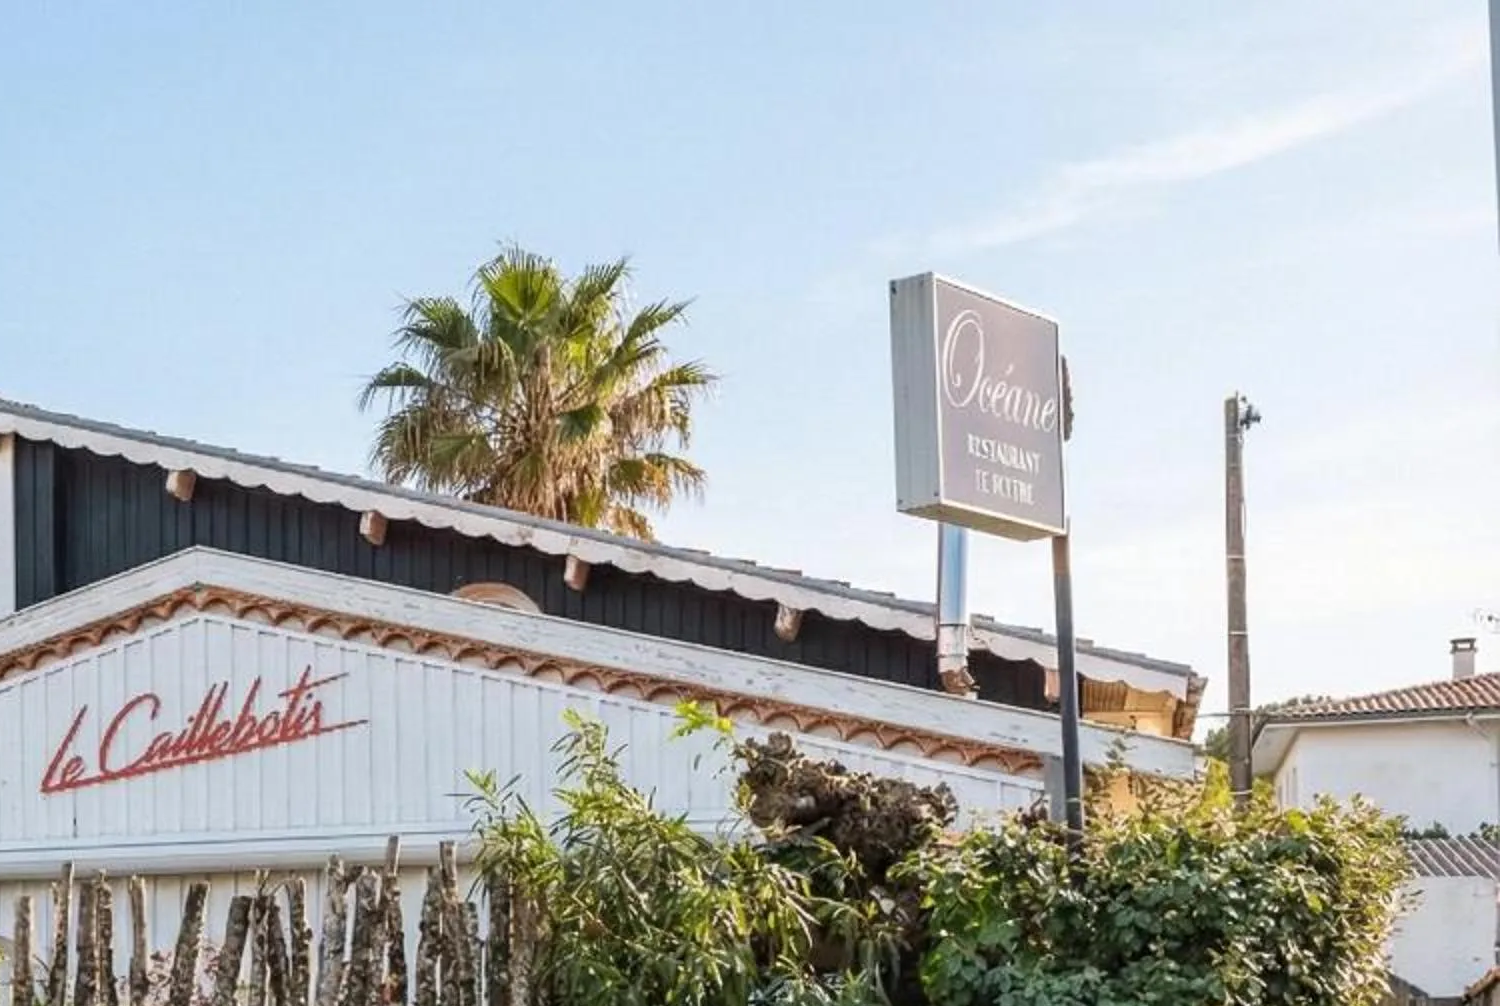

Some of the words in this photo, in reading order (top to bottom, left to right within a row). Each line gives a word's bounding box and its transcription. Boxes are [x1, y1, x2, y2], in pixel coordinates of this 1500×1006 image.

[943, 309, 1057, 432] Océane
[41, 704, 87, 792] Le
[99, 664, 369, 777] Caillebotis
